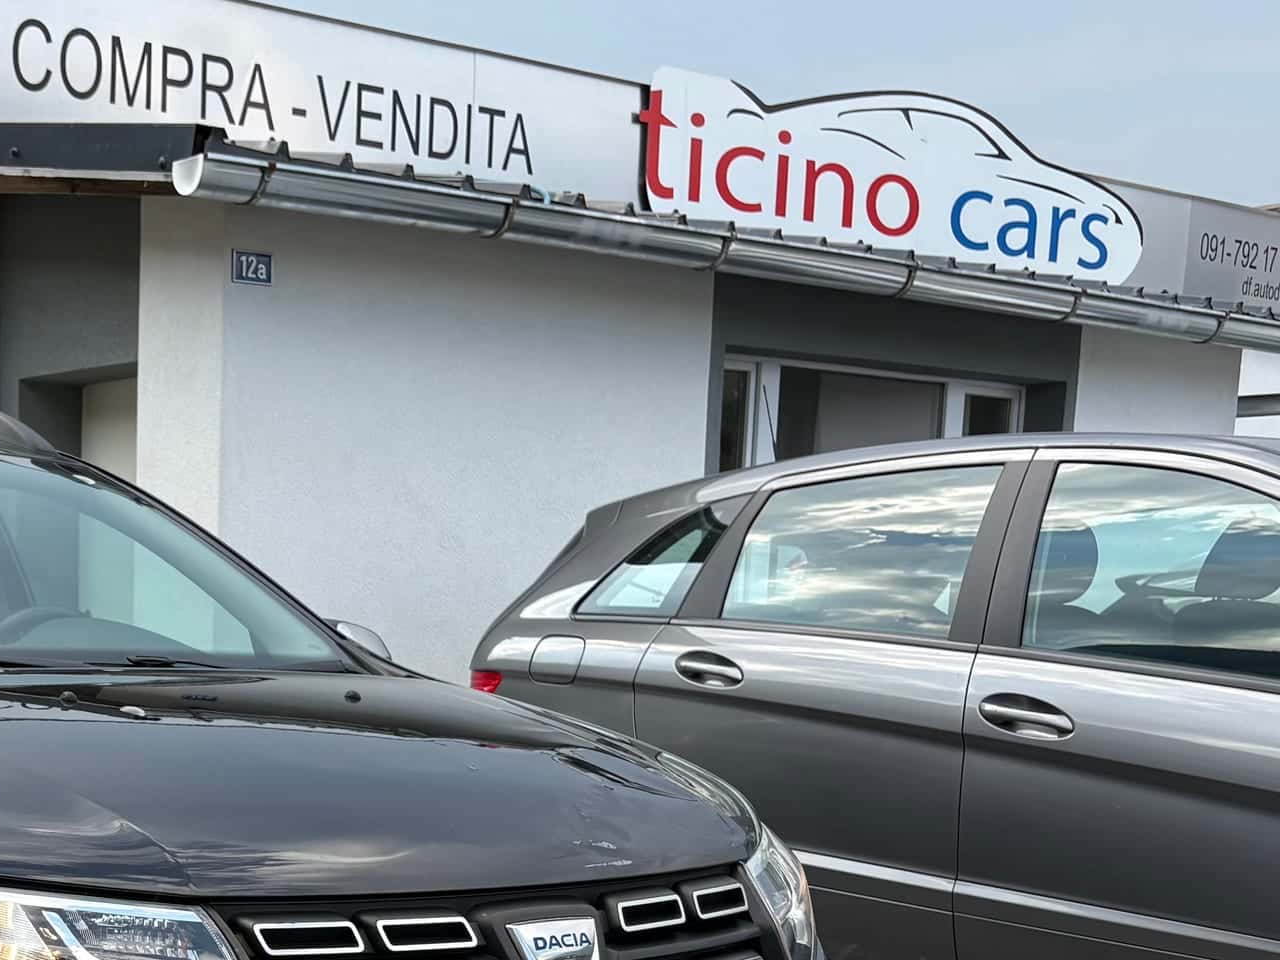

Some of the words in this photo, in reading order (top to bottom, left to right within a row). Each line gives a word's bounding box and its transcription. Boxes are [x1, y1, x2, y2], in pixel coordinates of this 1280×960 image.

[12, 17, 275, 131] COMPRA
[640, 89, 919, 237] ticino
[949, 189, 1109, 271] cars
[239, 255, 267, 279] 12a
[1200, 232, 1259, 270] 091-792
[1264, 245, 1278, 273] 17
[533, 932, 592, 951] DACIA
